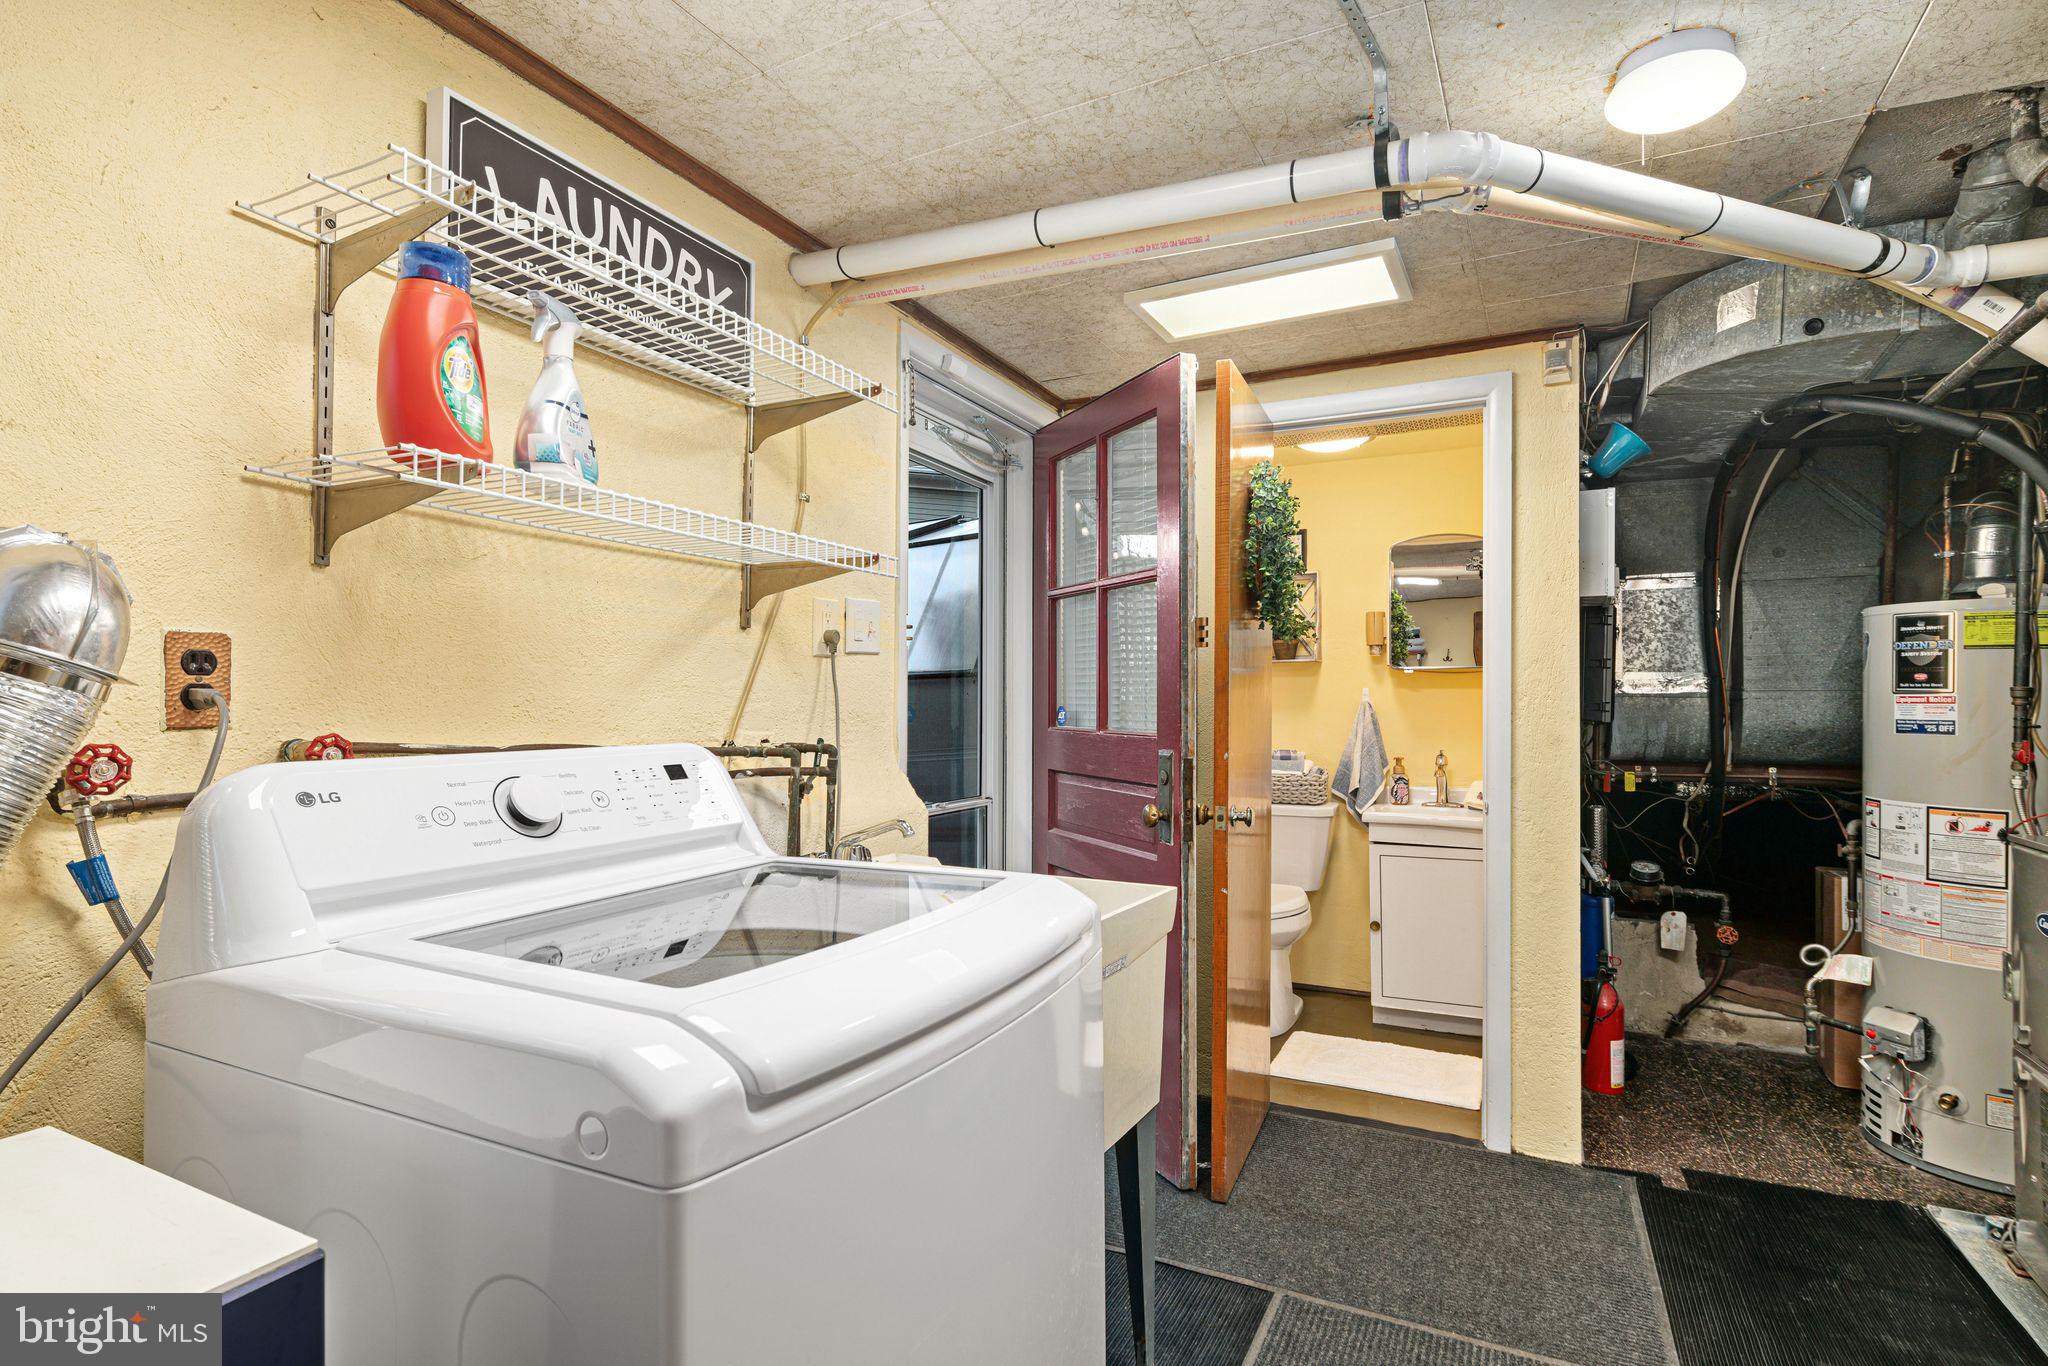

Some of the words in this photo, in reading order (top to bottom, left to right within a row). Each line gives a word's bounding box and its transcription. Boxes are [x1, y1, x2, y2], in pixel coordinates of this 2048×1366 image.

[485, 165, 733, 316] LAUNDRY
[448, 356, 472, 380] Tide
[1894, 640, 1953, 650] DEFENDER
[1896, 696, 1928, 704] Equipment
[1939, 724, 1955, 732] OFF
[318, 792, 342, 804] LG
[472, 838, 502, 848] Waterproof
